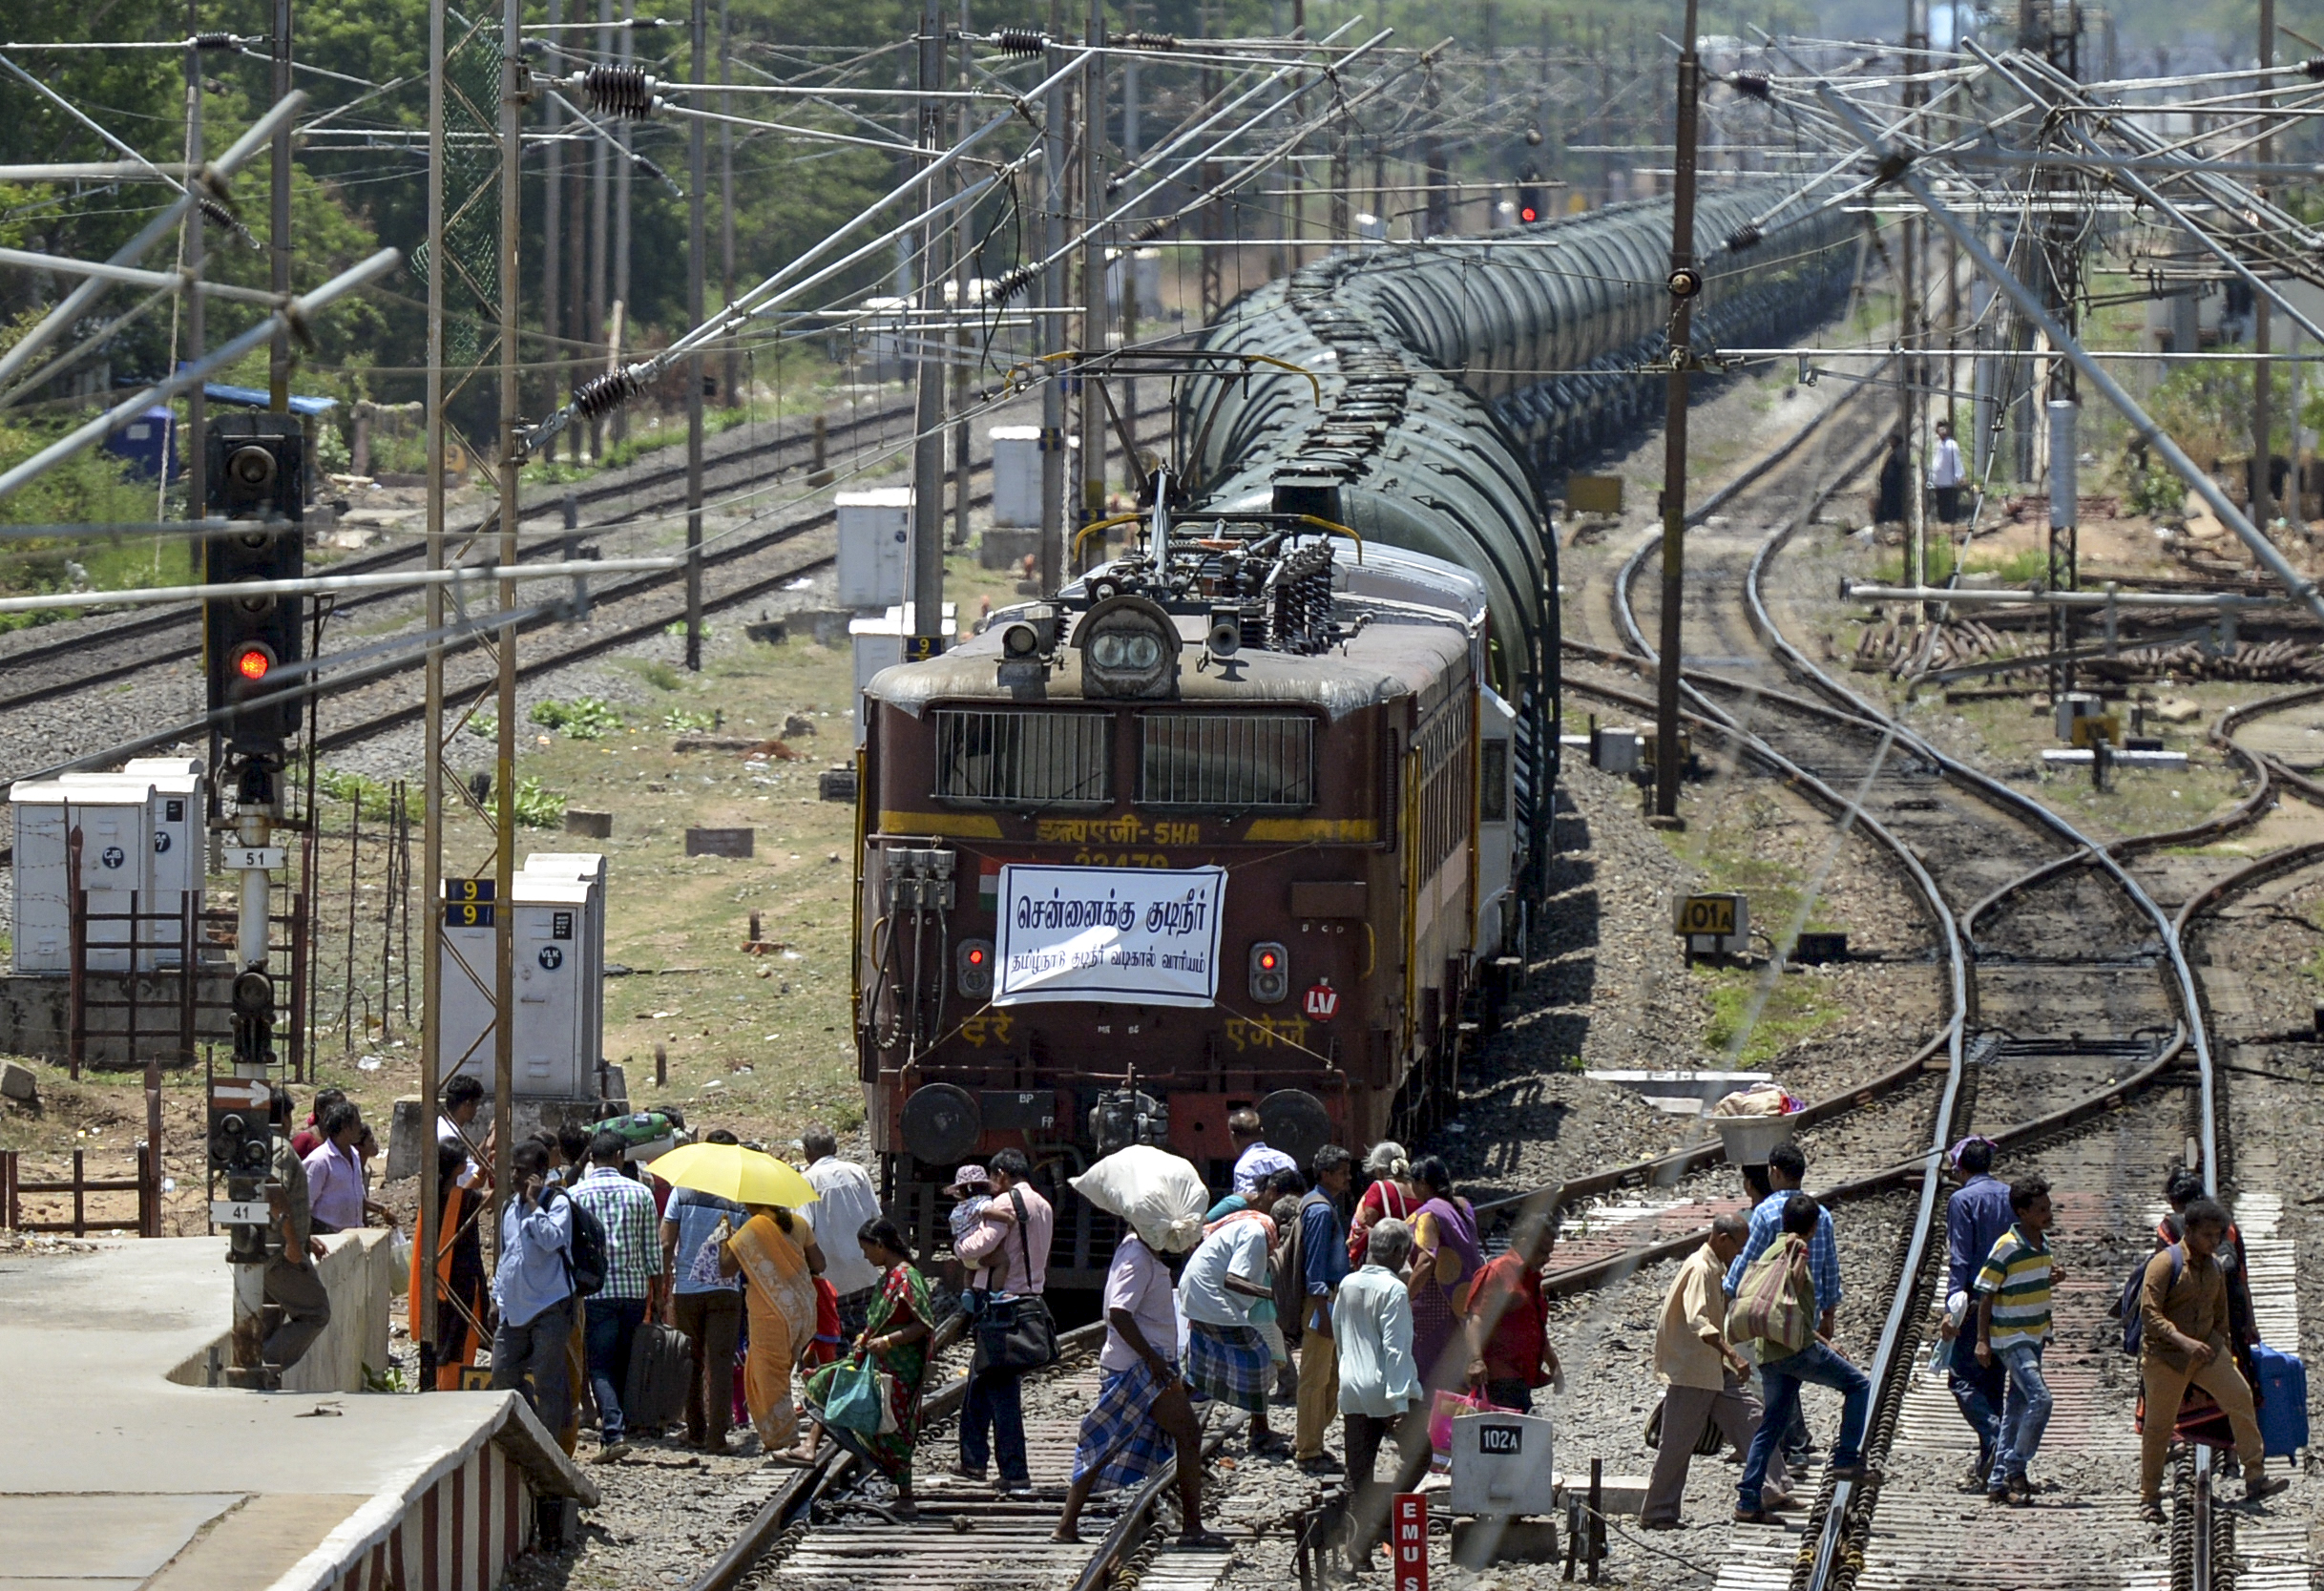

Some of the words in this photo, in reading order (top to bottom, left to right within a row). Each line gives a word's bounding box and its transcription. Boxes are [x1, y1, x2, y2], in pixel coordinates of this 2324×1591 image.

[919, 638, 930, 653] 9
[104, 848, 121, 859] CJB
[246, 851, 264, 866] 51
[463, 881, 478, 900] 9
[463, 905, 477, 925] 9
[1016, 887, 1136, 932] சென்னைக்கு
[1145, 887, 1207, 938] குடிநீர்
[541, 949, 559, 959] VLK
[1011, 948, 1066, 975] தமிழ்நாடு
[1072, 943, 1104, 970] குடிநீர்
[1111, 945, 1156, 971] வடிகால்
[1162, 950, 1206, 973] வாரியம்
[1308, 991, 1337, 1014] LV
[1019, 1093, 1034, 1104] BP
[1041, 1116, 1054, 1128] FP
[233, 1205, 249, 1220] 41
[1483, 1430, 1518, 1450] 102A
